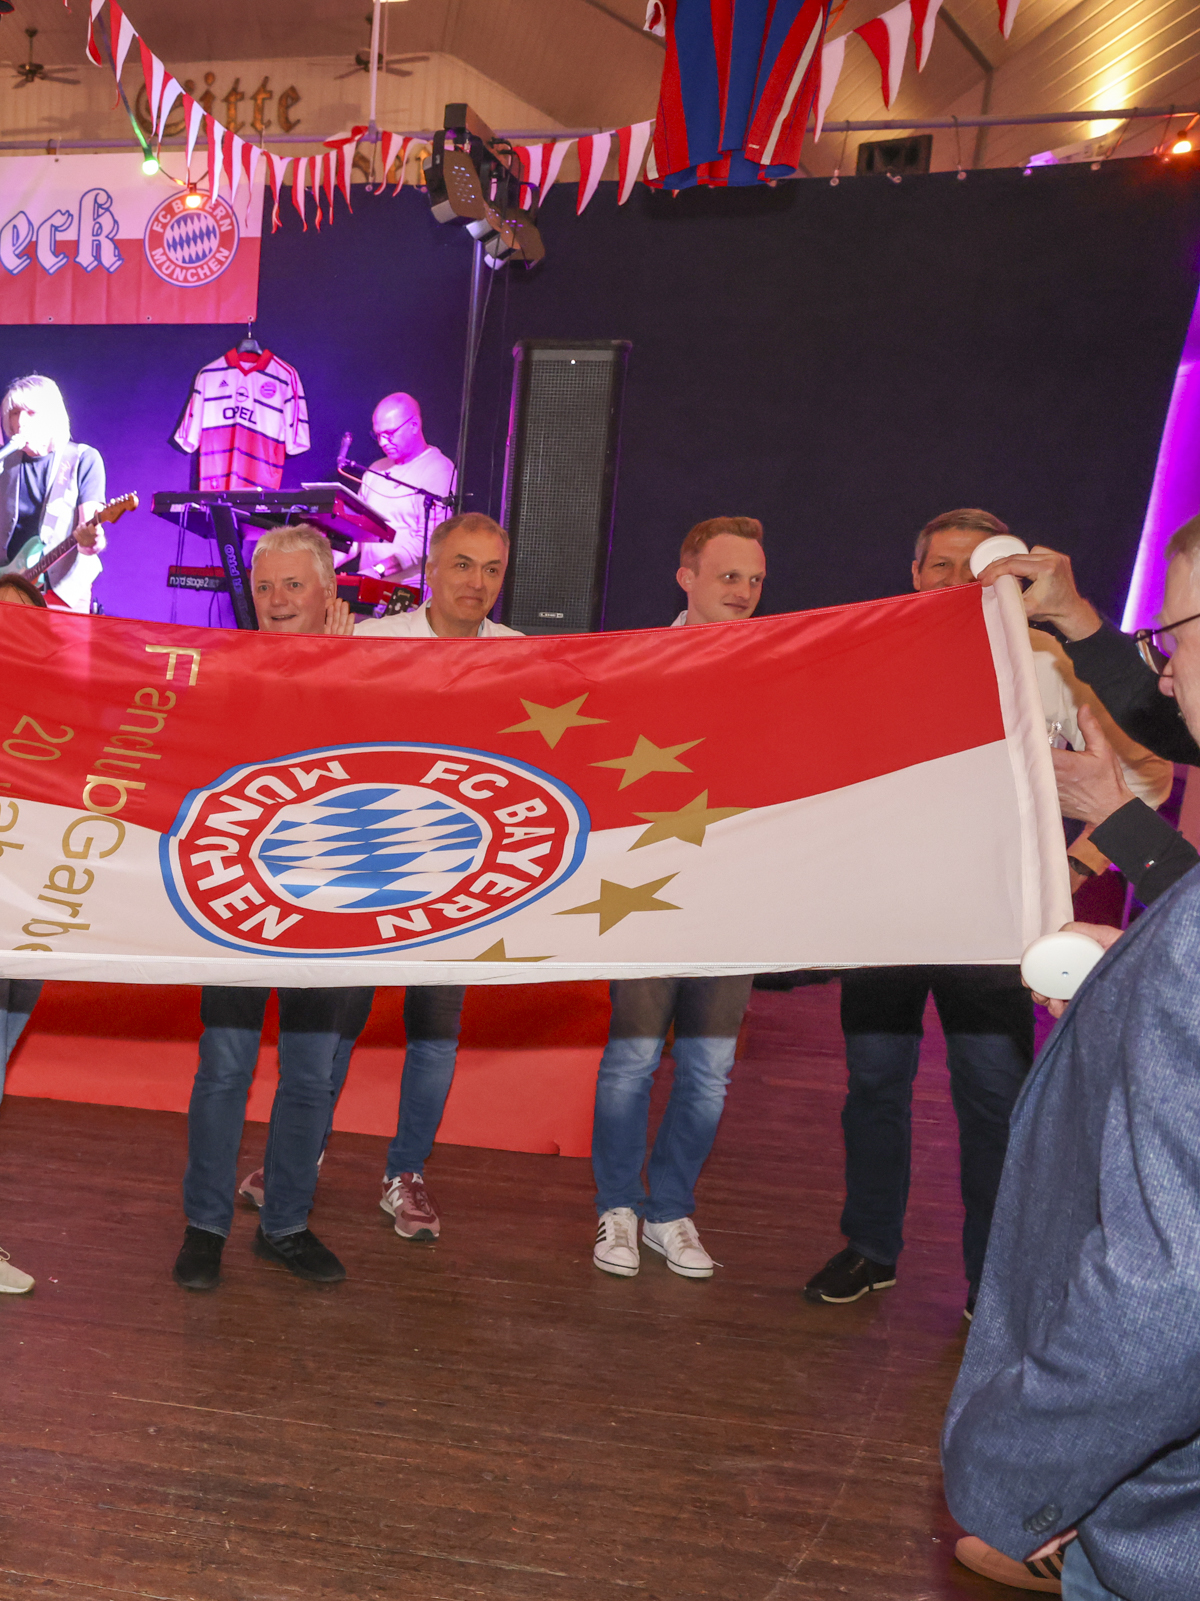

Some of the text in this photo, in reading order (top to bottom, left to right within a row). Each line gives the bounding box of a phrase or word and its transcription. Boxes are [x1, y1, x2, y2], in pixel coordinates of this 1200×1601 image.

[152, 210, 171, 233] FC
[223, 406, 257, 425] OPEL
[2, 715, 75, 761] 20
[83, 644, 201, 814] Fanclub
[190, 760, 351, 941] MÜNCHEN
[376, 760, 555, 939] FC BAYERN
